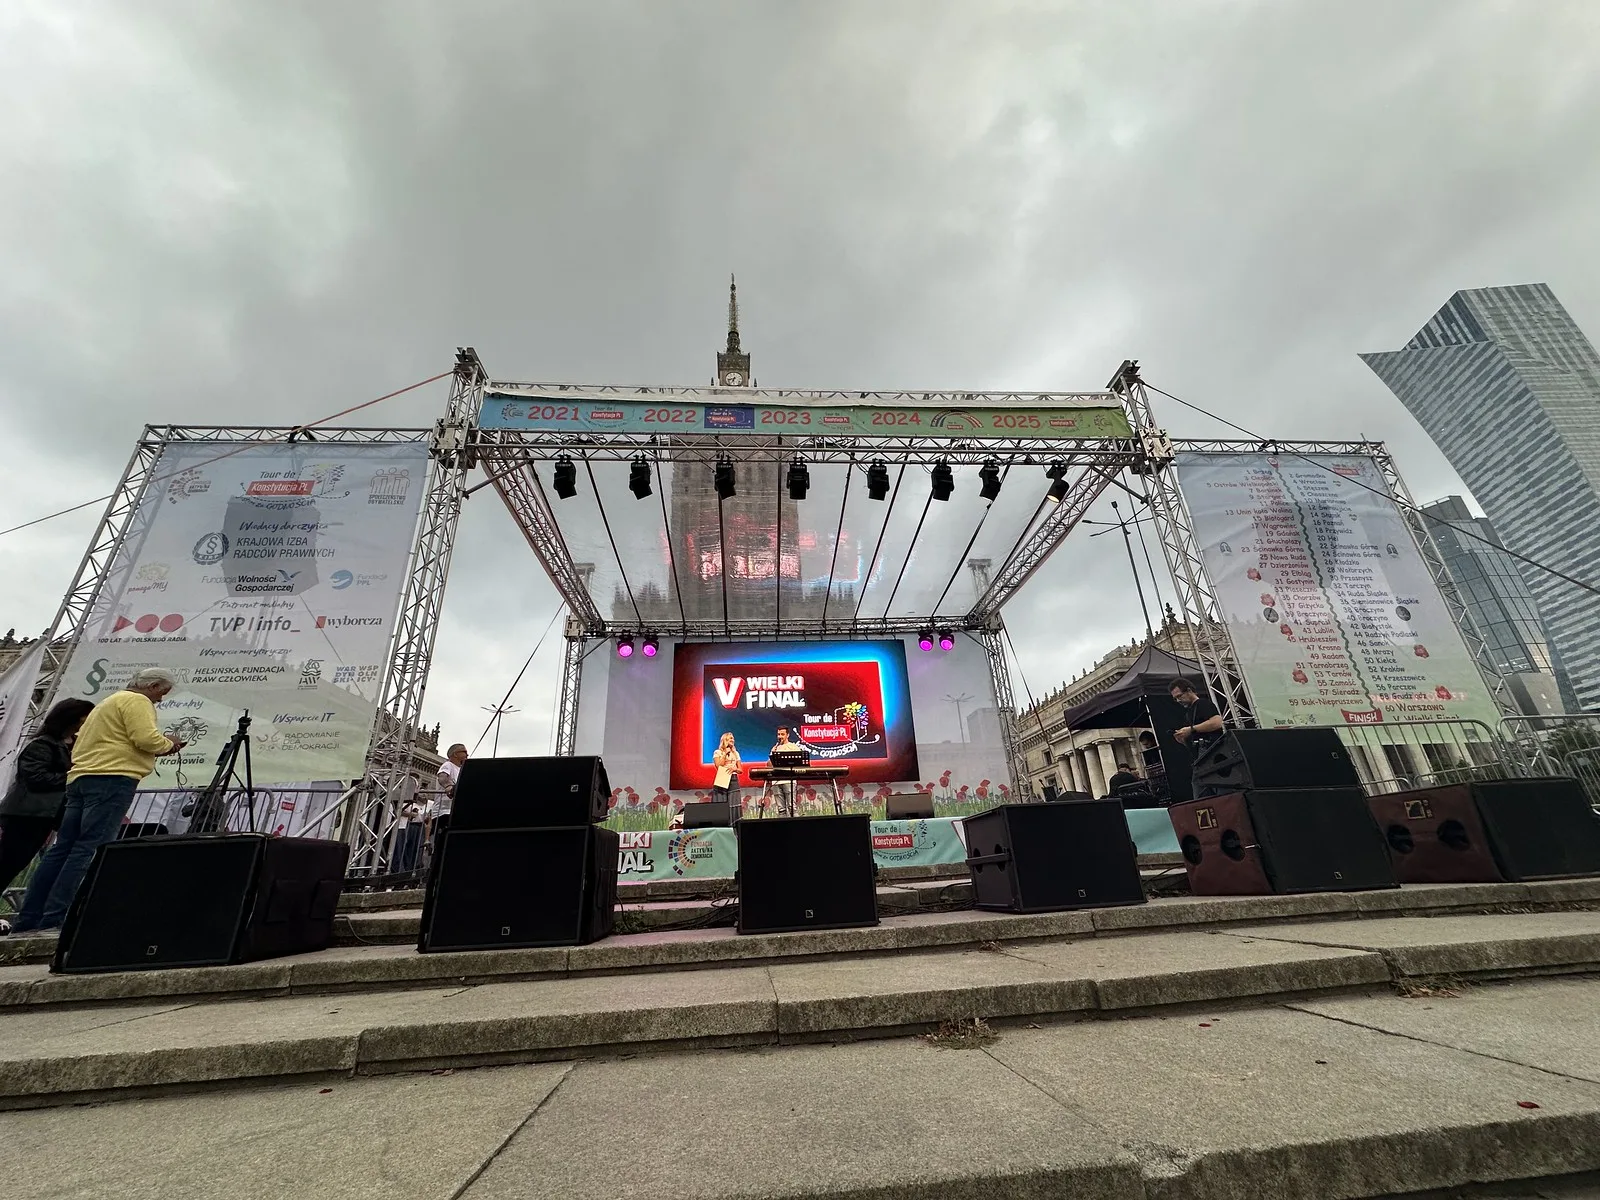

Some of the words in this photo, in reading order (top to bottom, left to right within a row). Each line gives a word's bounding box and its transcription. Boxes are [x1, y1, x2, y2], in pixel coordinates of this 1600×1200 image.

[528, 406, 580, 420] 2021
[644, 409, 696, 423] 2022
[761, 410, 811, 425] 2023
[871, 412, 921, 425] 2024
[992, 415, 1041, 428] 2025
[260, 471, 281, 479] Tour
[283, 470, 296, 478] de
[251, 482, 298, 494] Konstytucja
[300, 482, 308, 491] PL
[236, 538, 283, 547] KRAJOWA
[286, 537, 308, 546] IZBA
[233, 548, 277, 559] RADCÓW
[280, 548, 335, 558] PRAWNYCH
[201, 576, 237, 584] Fundacja
[238, 575, 277, 583] Wolności
[235, 584, 294, 593] Gospodarczej
[210, 617, 245, 632] TVP
[327, 615, 382, 629] wyborcza
[194, 666, 240, 674] HELSIŃSKA
[242, 666, 285, 674] FUNDACJA
[1308, 662, 1349, 670] Tarnobrzeg
[192, 675, 217, 683] PRAW
[746, 675, 805, 690] WIELKI
[712, 677, 746, 709] V
[1301, 698, 1363, 707] Buk-Niepruszewo
[1396, 703, 1445, 711] Warszawa
[272, 713, 319, 724] Wsparcie
[320, 712, 335, 722] IT
[803, 714, 821, 723] Tour
[823, 712, 832, 723] de
[1348, 711, 1378, 722] FINISH
[804, 728, 839, 739] Konstytucja
[159, 756, 205, 765] Krakowie
[620, 832, 652, 850] LKI
[874, 837, 904, 846] Konstytucja
